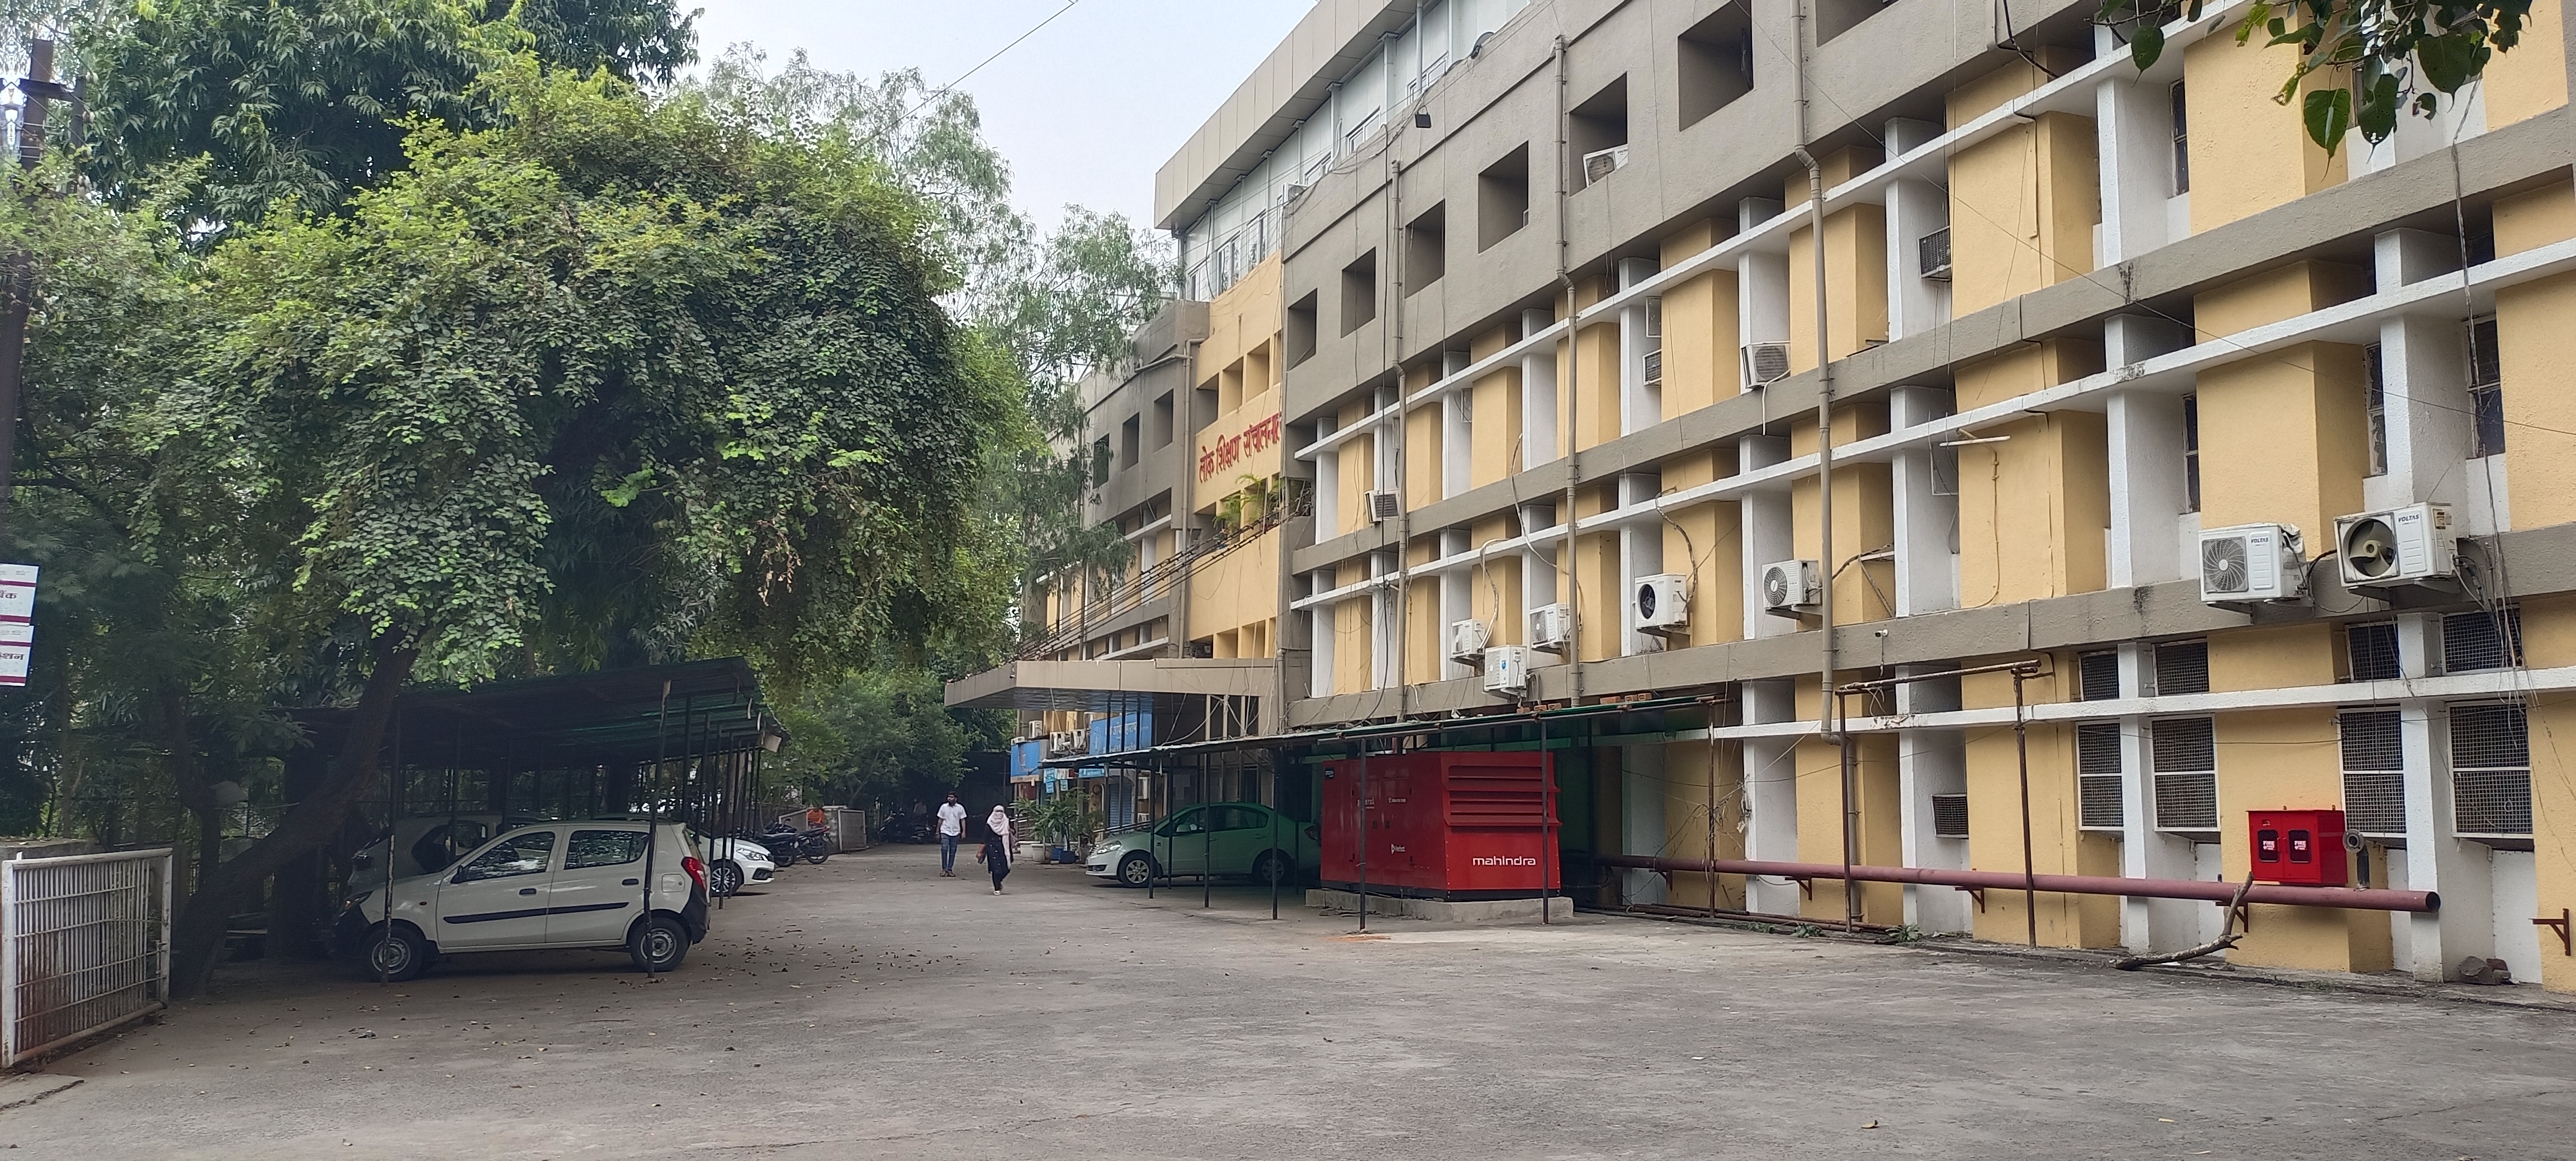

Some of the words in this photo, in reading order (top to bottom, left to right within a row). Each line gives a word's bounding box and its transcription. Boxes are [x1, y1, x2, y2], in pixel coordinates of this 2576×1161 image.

[1200, 445, 1215, 483] लोक
[1216, 434, 1242, 475] शिक्षण
[2398, 514, 2419, 522] VOLTAS
[1472, 855, 1536, 866] mahindra
